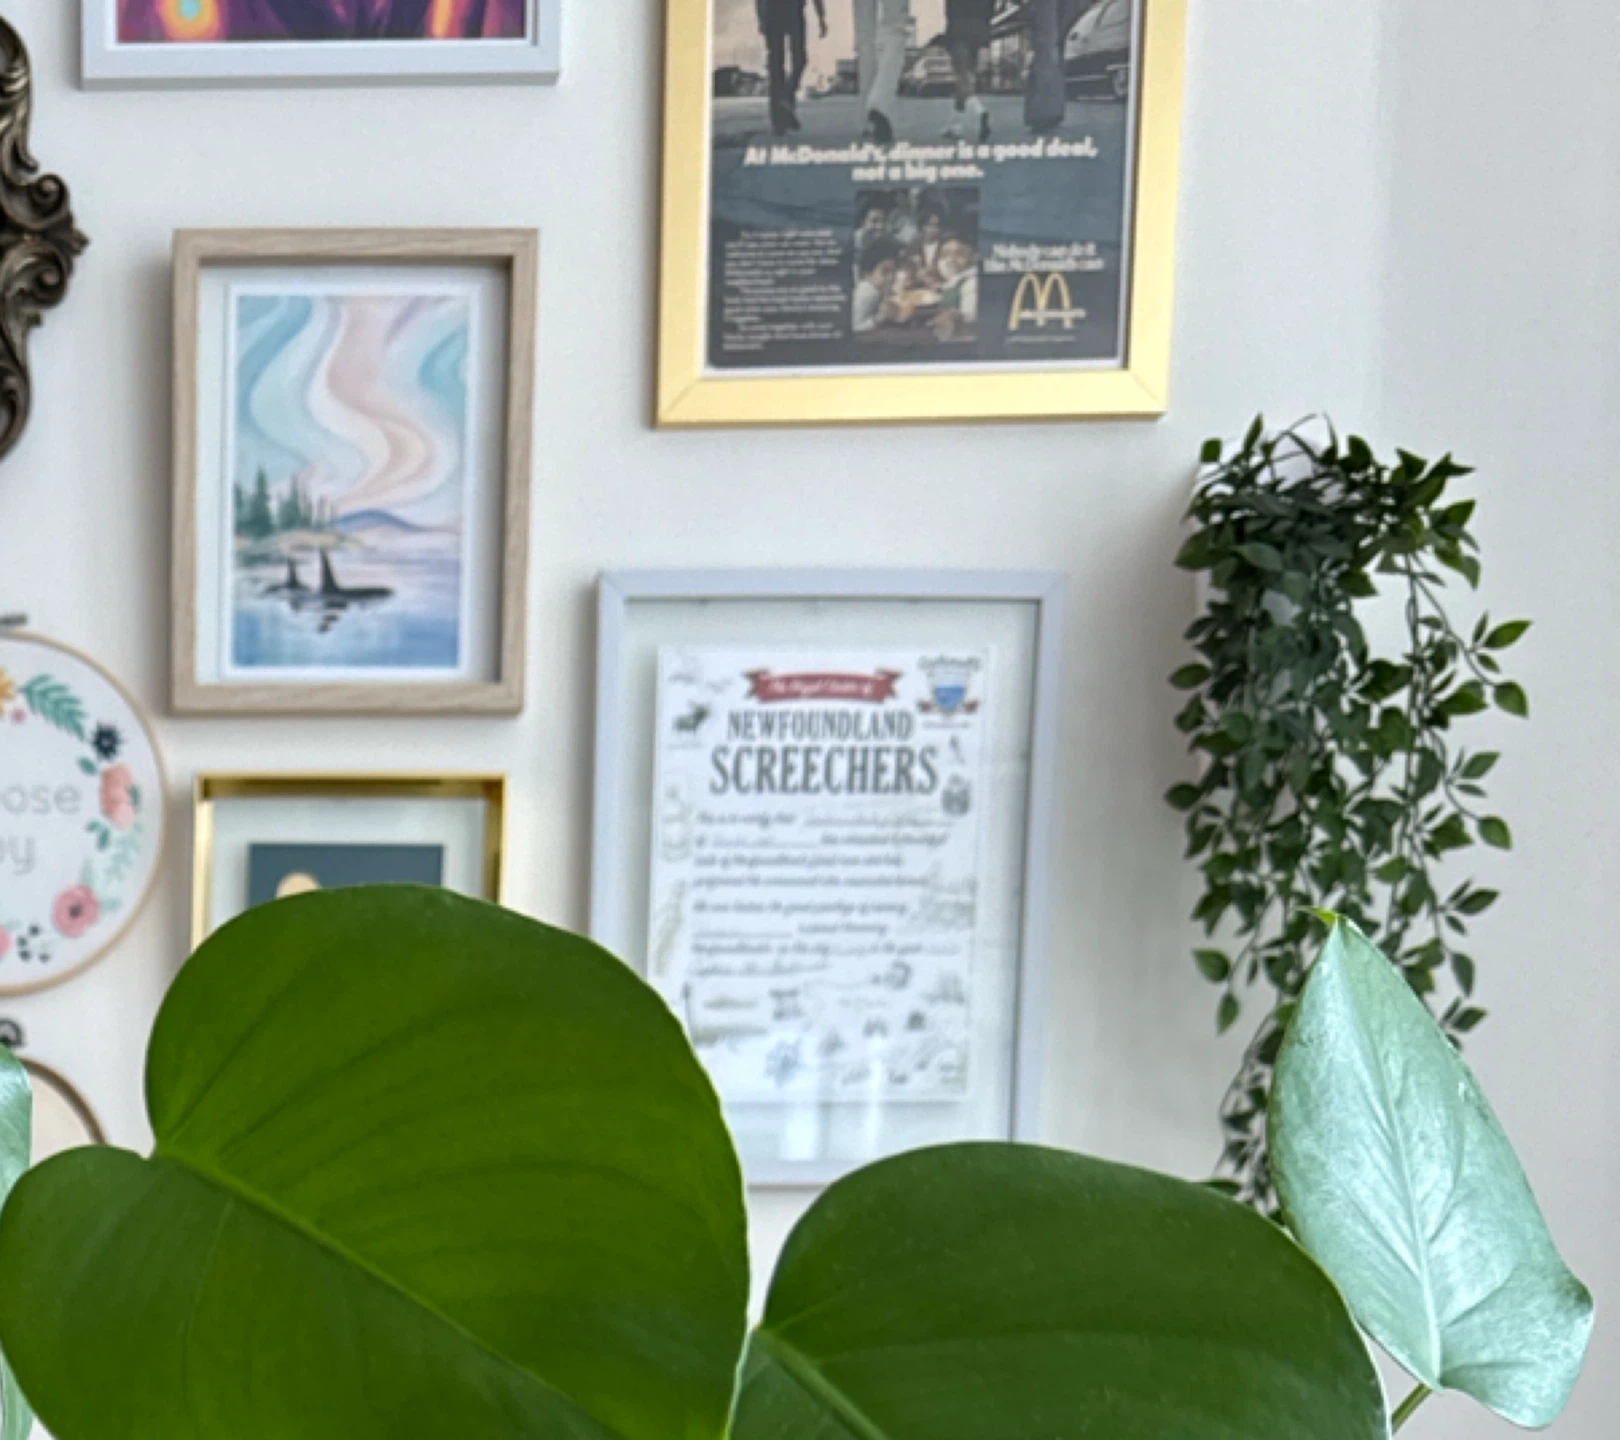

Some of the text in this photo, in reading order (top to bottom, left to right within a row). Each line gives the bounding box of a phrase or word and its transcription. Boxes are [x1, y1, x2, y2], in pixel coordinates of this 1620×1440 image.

[889, 141, 955, 163] dinner
[957, 139, 974, 160] is
[977, 143, 990, 160] a
[993, 136, 1044, 163] good
[851, 162, 885, 181] not
[888, 166, 901, 181] a
[905, 160, 938, 183] big
[728, 709, 915, 741] NEWFOUNDLAND
[709, 744, 939, 795] SCREECHERS
